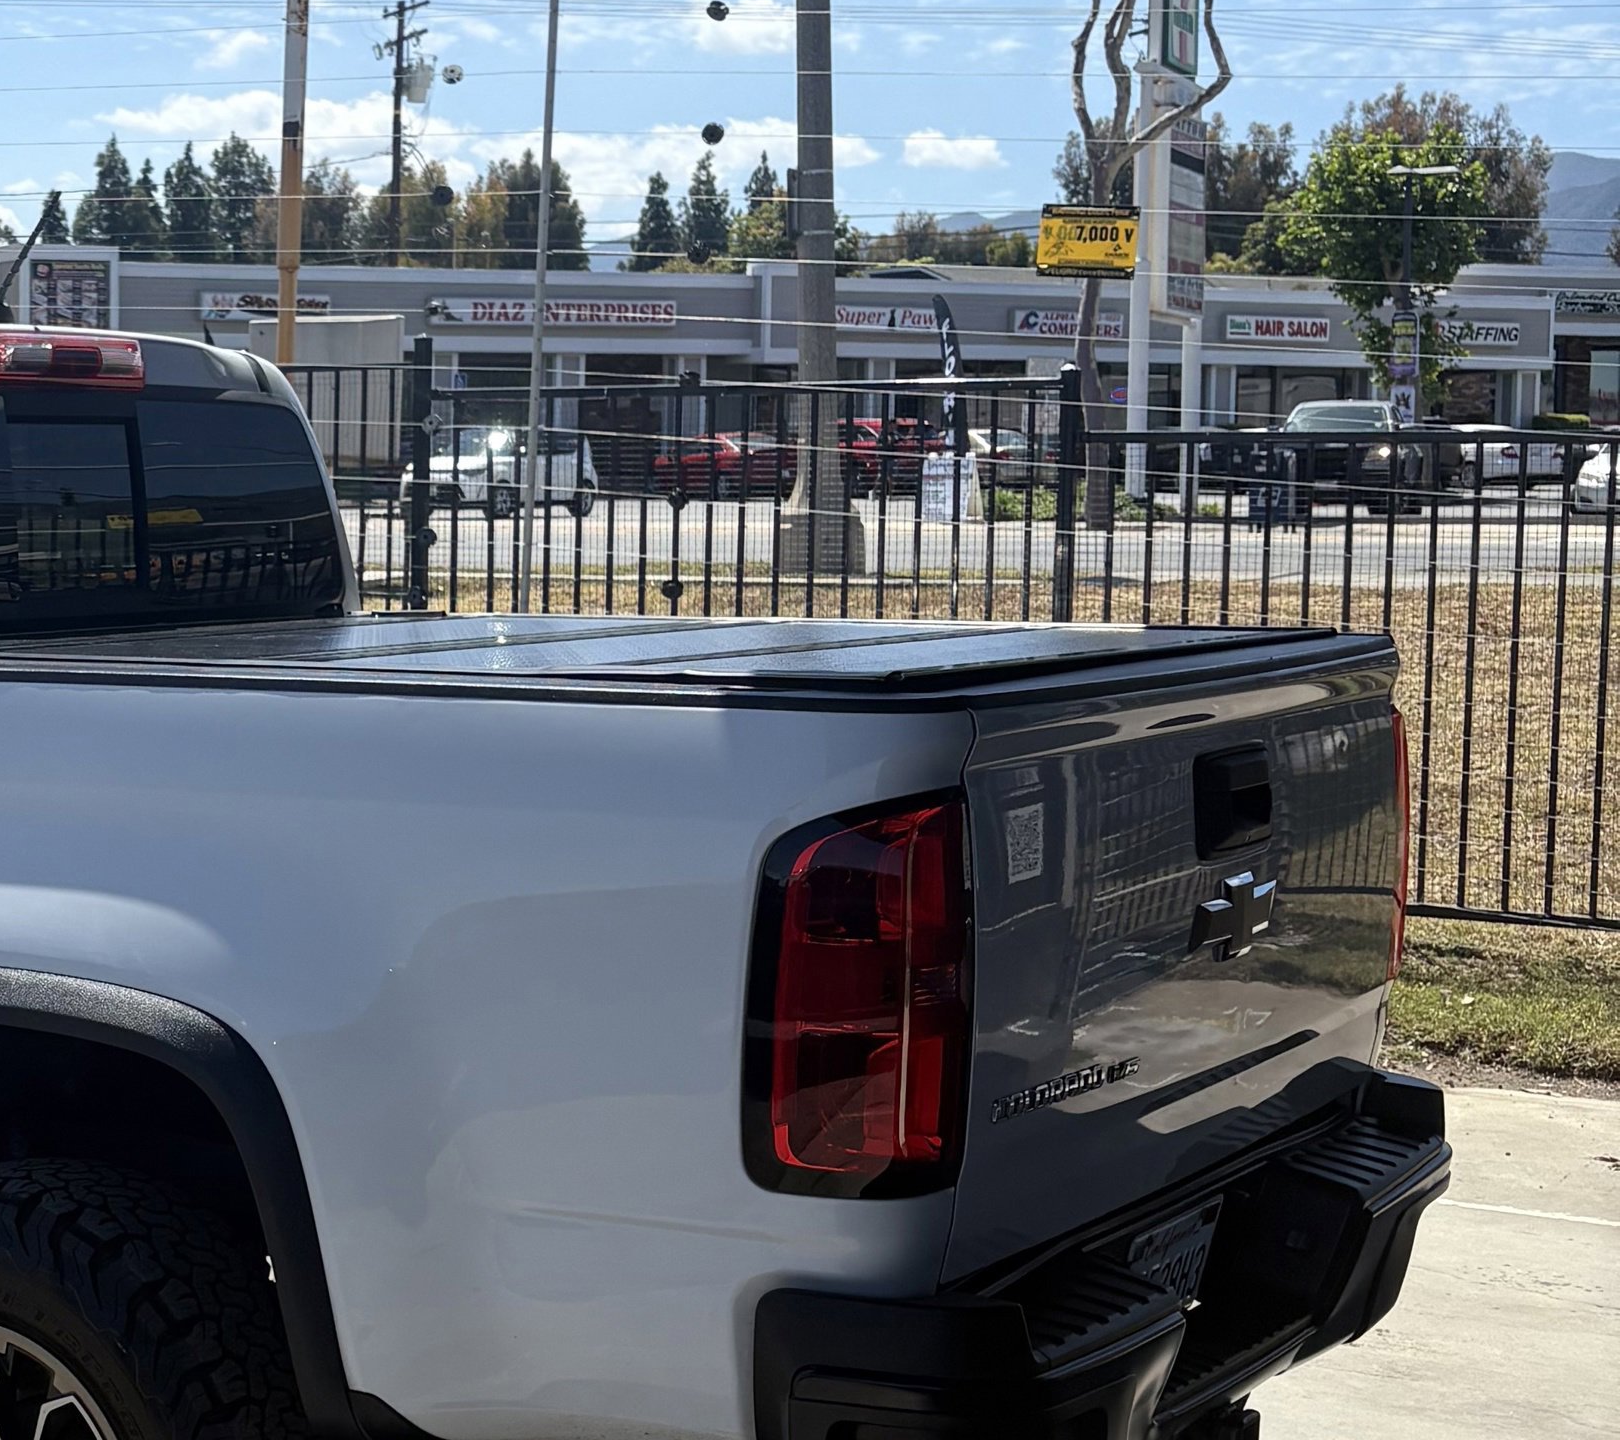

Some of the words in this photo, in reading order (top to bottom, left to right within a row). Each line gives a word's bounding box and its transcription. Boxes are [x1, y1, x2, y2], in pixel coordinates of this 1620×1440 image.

[1076, 225, 1119, 244] 7,000
[1125, 228, 1135, 243] V
[472, 302, 525, 322] DIAZ
[533, 302, 674, 323] NTERPRISES
[837, 307, 886, 326] Super
[1039, 322, 1121, 337] COMPERS
[1255, 320, 1285, 336] HAIR
[1288, 321, 1328, 338] SALON
